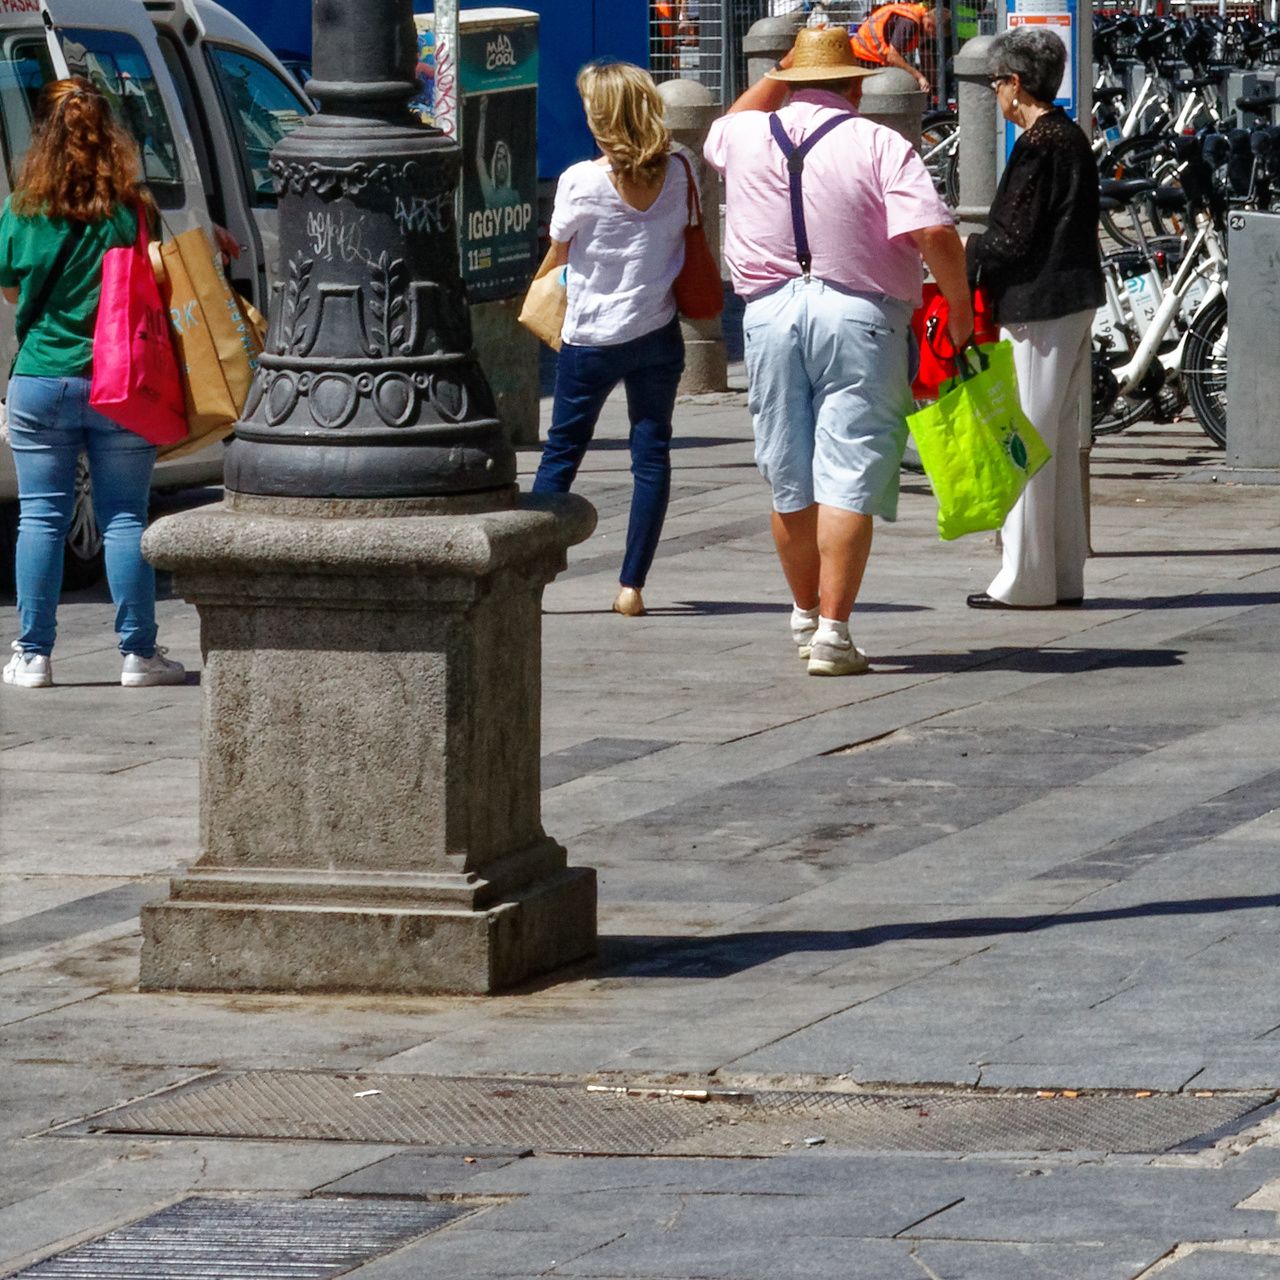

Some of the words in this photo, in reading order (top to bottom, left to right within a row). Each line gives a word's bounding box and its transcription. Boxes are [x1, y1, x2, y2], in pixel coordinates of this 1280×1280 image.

[486, 34, 512, 52] MAD
[486, 49, 517, 71] COOL
[468, 207, 502, 240] IGGY
[504, 203, 532, 234] POP
[1231, 217, 1244, 228] 24
[467, 249, 480, 271] 11
